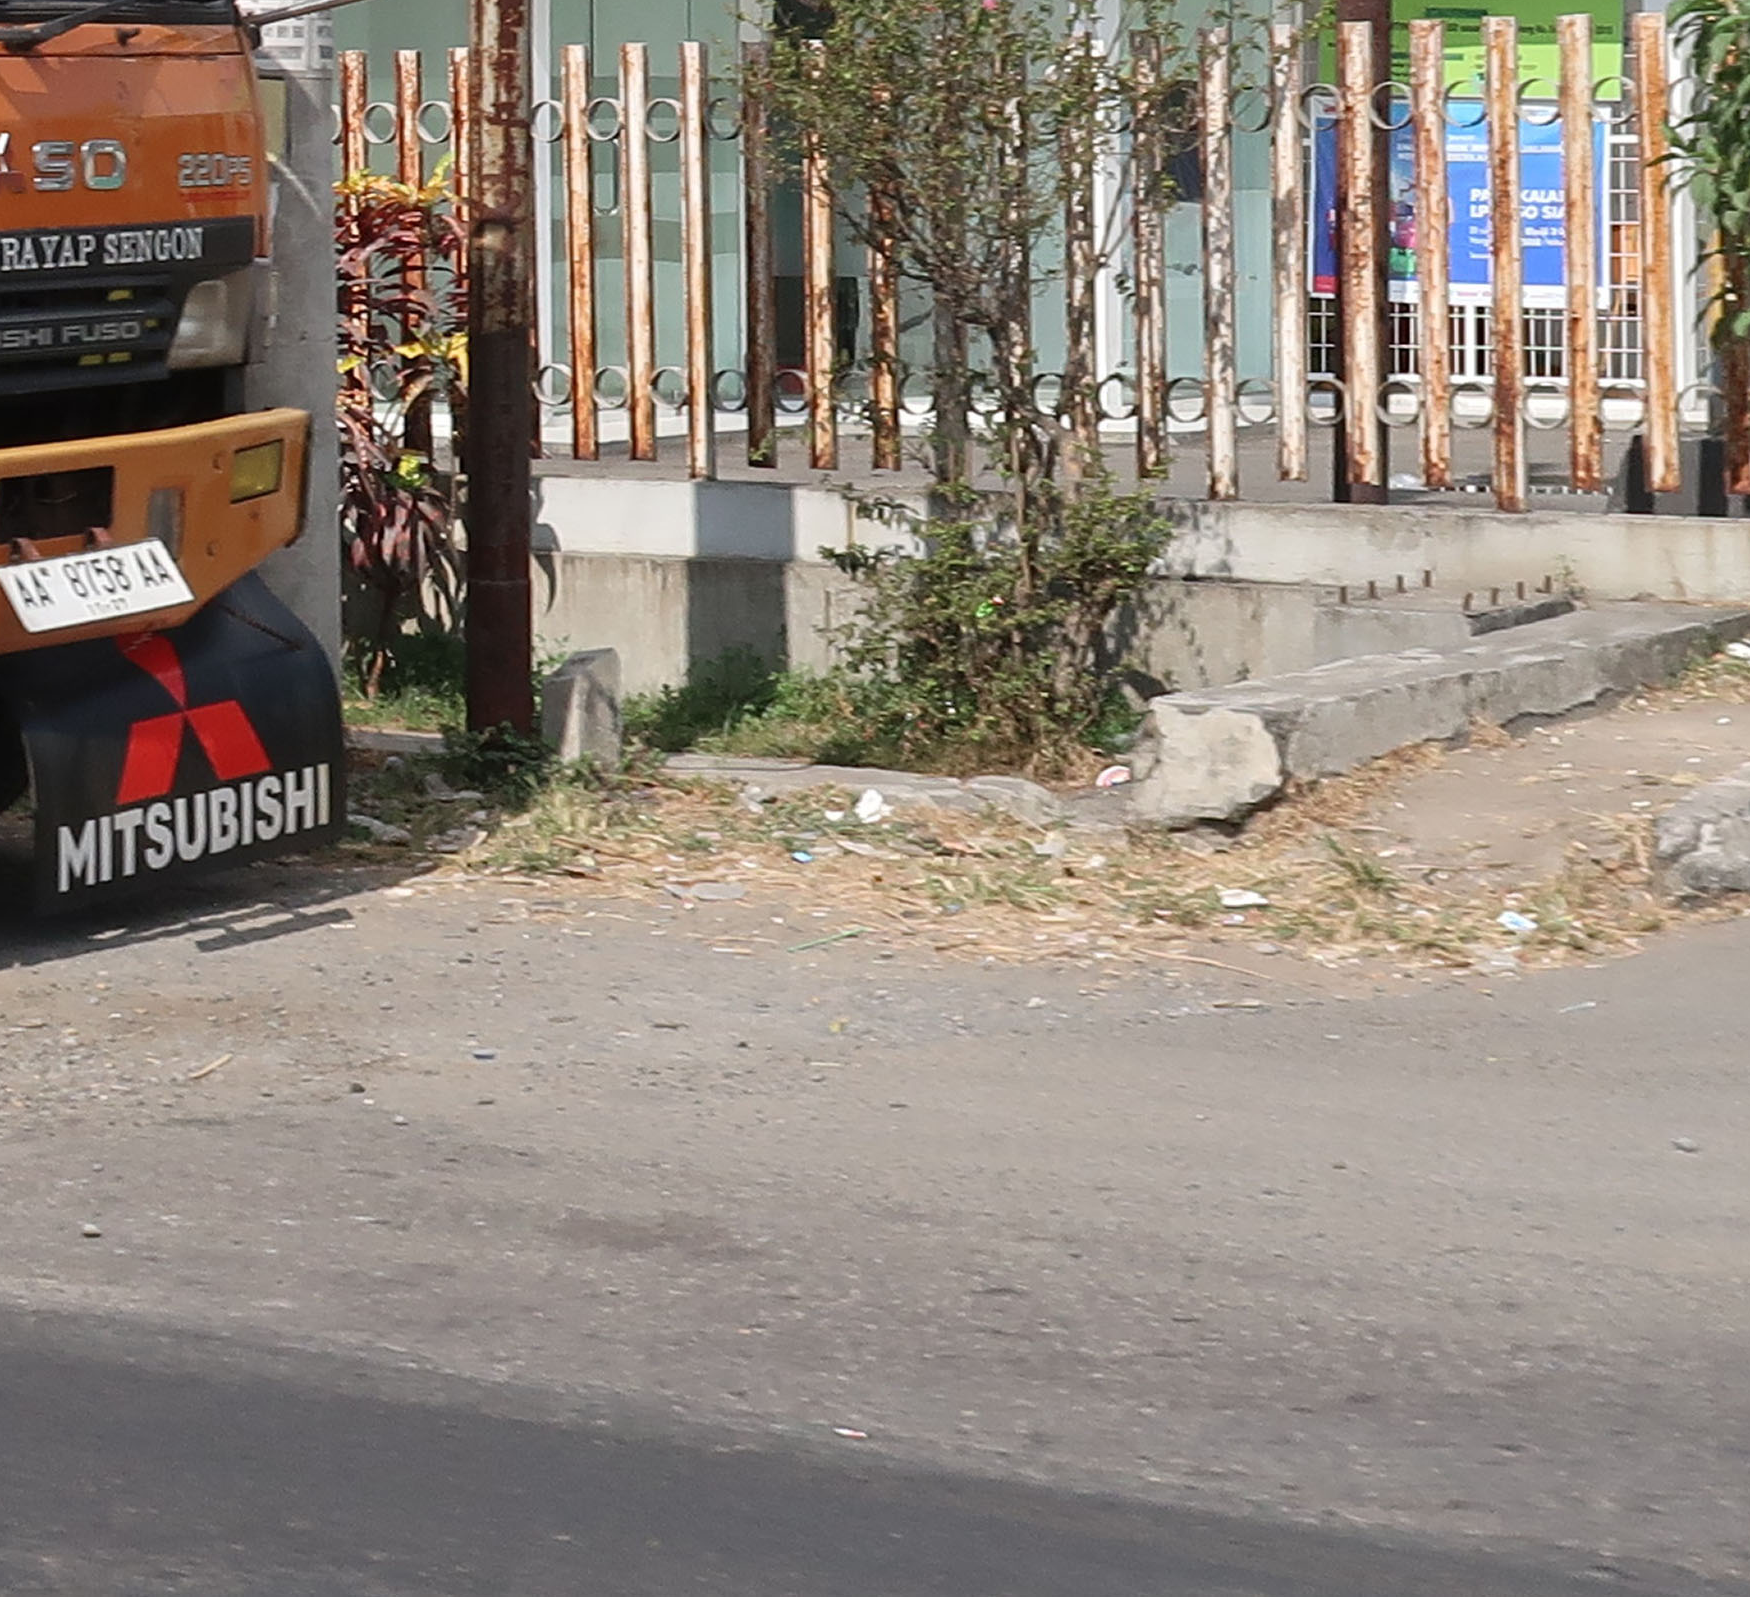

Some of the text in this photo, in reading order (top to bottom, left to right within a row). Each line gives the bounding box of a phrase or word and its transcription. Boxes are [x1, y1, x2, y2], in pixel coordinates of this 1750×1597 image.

[1469, 188, 1565, 202] PAKALA
[0, 232, 97, 272] RAYAP
[103, 227, 203, 263] SENGON
[61, 319, 142, 348] FUSO
[14, 547, 175, 608] AA 8758 AA
[56, 763, 331, 893] MITSUBISHI
